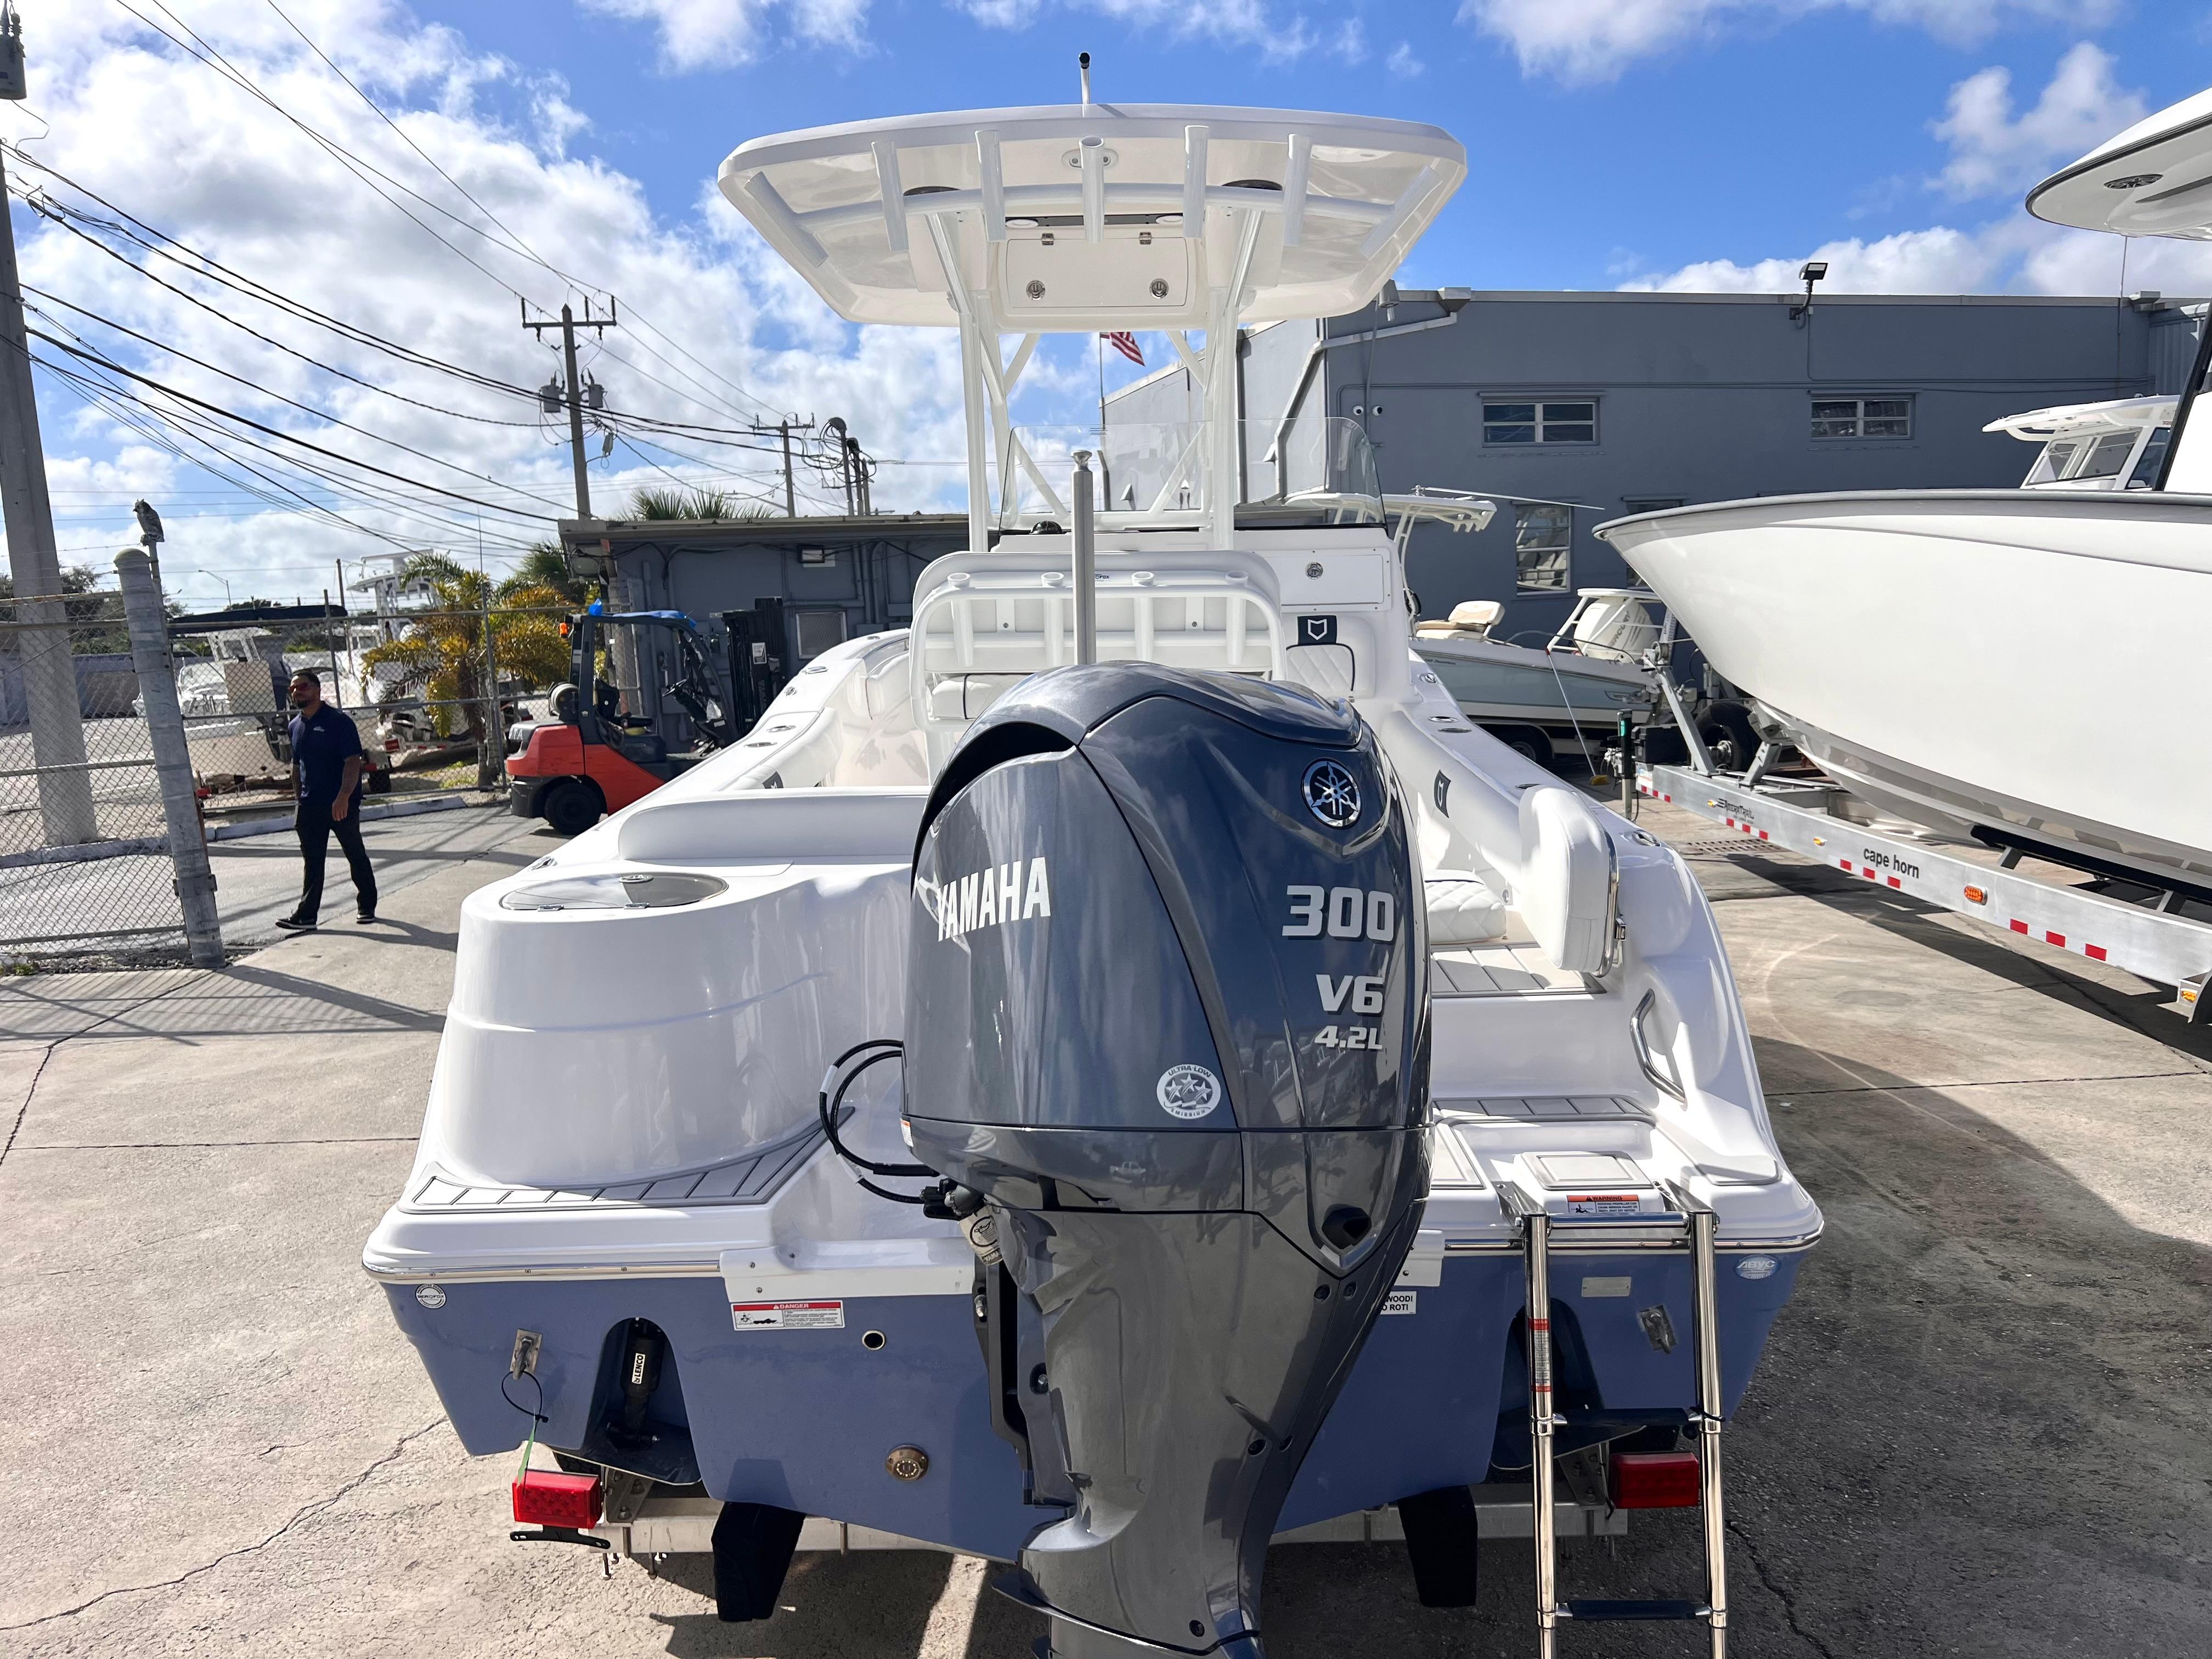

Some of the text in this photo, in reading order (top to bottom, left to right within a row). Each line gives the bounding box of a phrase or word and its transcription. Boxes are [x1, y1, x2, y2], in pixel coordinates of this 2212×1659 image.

[1864, 848, 1919, 879] cape horn
[936, 856, 1051, 942] YAMAHA
[1282, 884, 1395, 942] 300
[1315, 974, 1385, 1014] V6
[1314, 1025, 1384, 1050] 4.2L
[634, 1355, 644, 1378] LENCO
